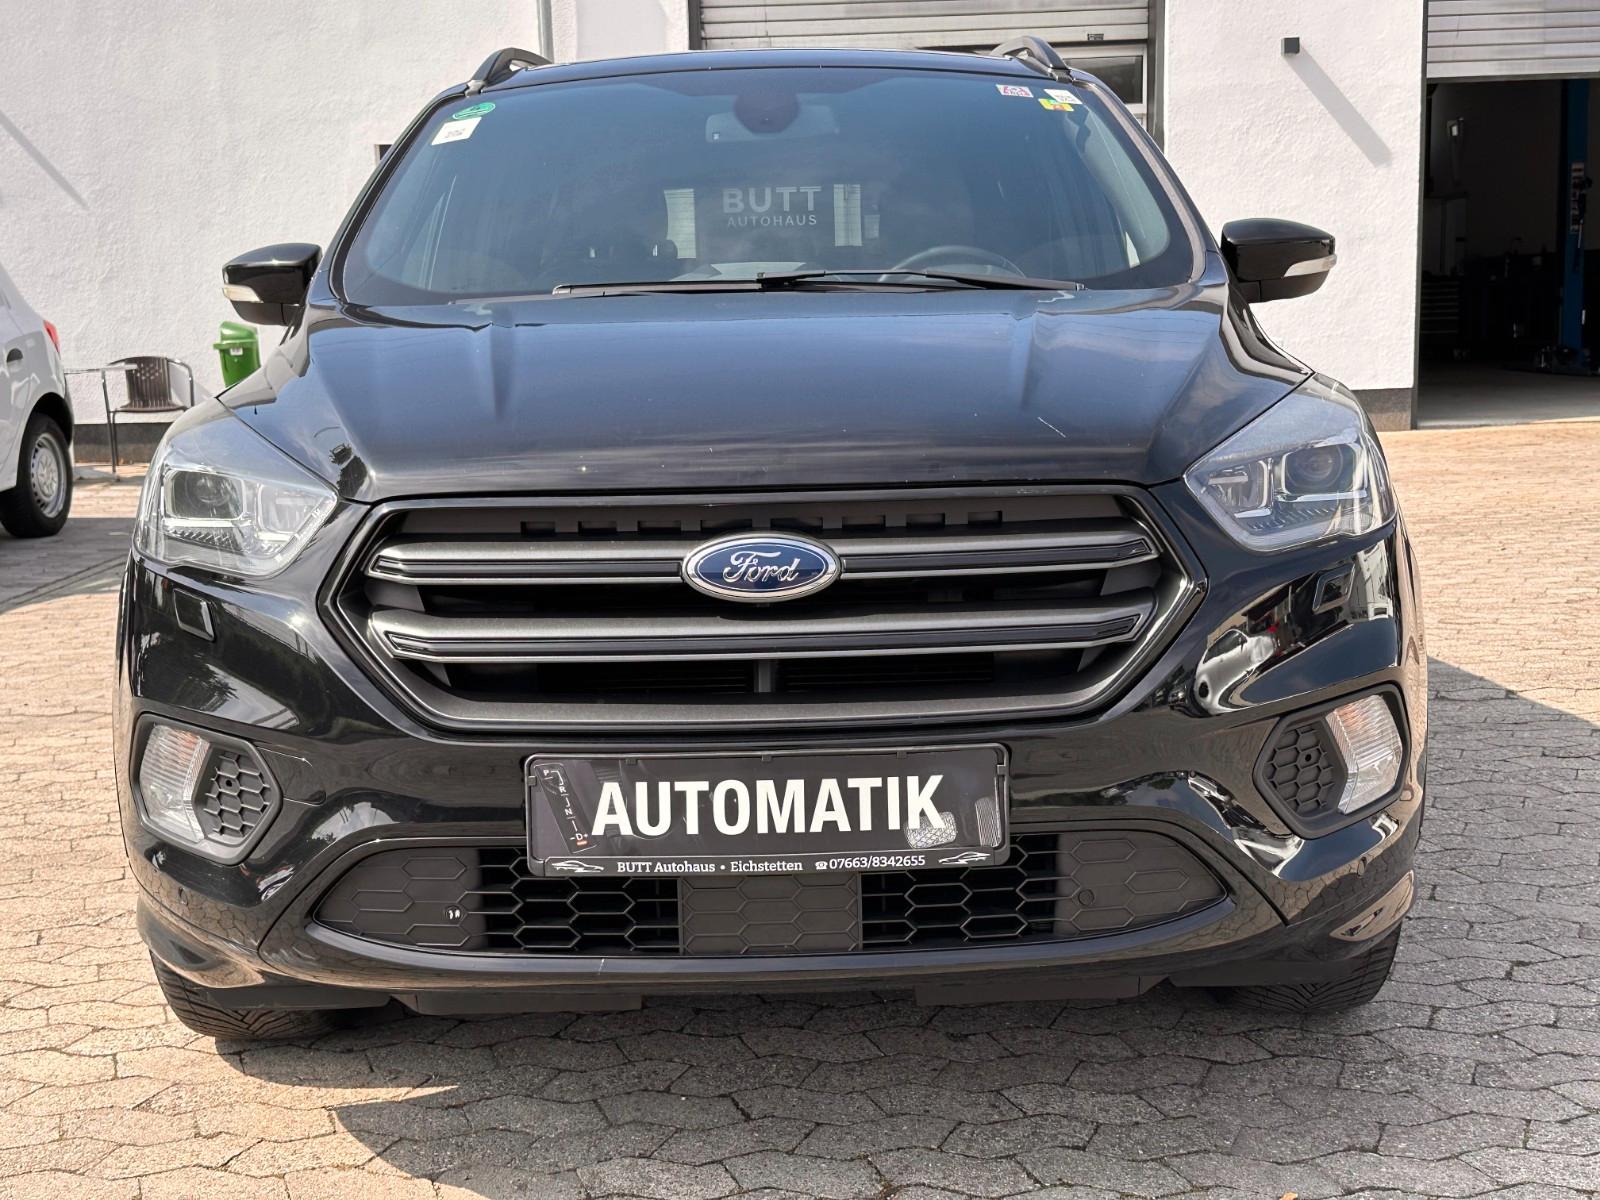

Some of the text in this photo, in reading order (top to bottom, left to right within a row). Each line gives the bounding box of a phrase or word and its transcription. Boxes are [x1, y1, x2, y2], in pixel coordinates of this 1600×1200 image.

[723, 186, 822, 213] BUTT
[727, 214, 817, 227] AUTOHAUS
[722, 550, 801, 583] Ford
[591, 774, 946, 836] AUTOMATIK
[617, 855, 926, 873] BUTT Autohaus Eichstetten 07663/8342655
